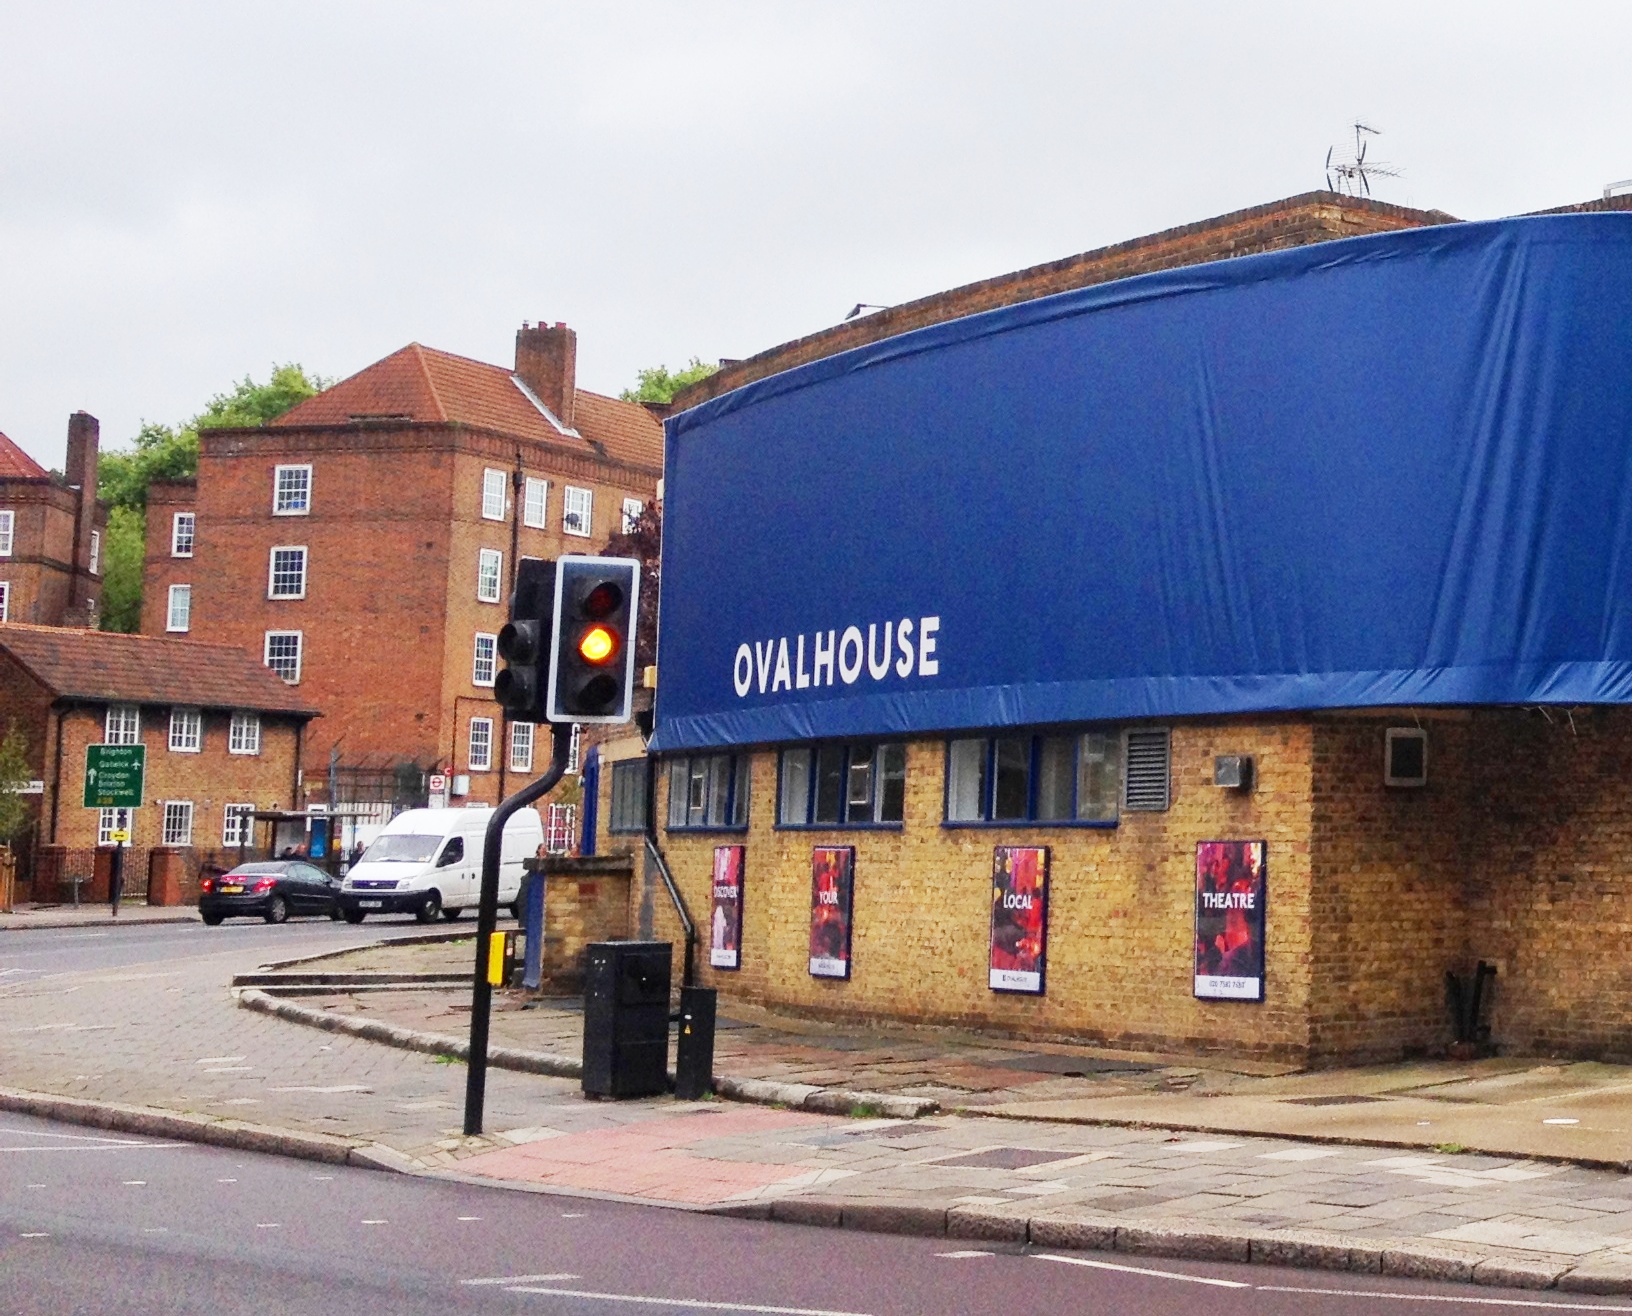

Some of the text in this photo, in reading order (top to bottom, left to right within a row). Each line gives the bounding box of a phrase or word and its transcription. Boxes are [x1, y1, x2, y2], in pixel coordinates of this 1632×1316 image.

[734, 616, 940, 697] OVALHOUSE
[713, 886, 737, 898] DISCOVER
[819, 891, 839, 904] YOUR
[1003, 890, 1033, 909] LOCAL
[1202, 892, 1255, 908] THEATRE
